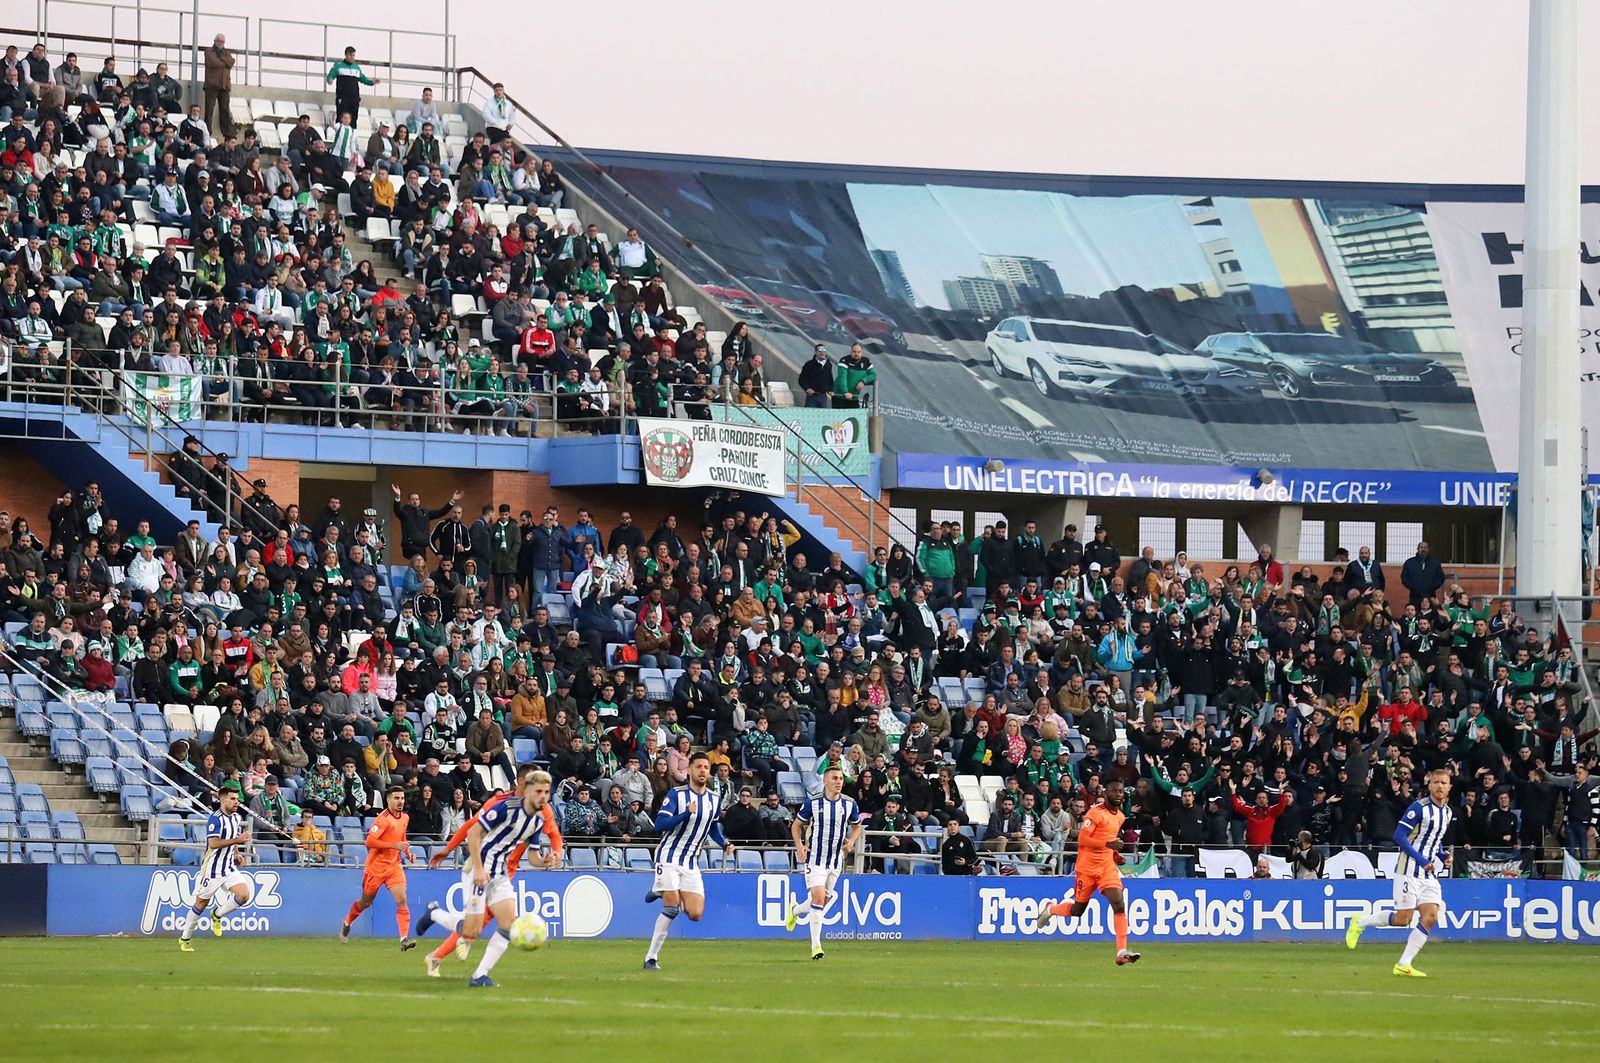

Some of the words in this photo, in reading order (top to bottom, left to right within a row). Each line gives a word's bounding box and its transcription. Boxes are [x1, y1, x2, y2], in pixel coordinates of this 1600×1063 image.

[692, 424, 717, 442] PEÑA
[719, 428, 782, 451] CORDOBESISTA
[709, 466, 738, 483] CRUZ
[944, 465, 1136, 497] UNIELECTRICA
[1179, 479, 1255, 501] energía
[1263, 480, 1295, 502] del
[1402, 882, 1409, 894] 3
[141, 870, 283, 935] MUOZ
[1152, 889, 1245, 936] Palos
[162, 911, 270, 931] deoación
[825, 930, 854, 940] ciudad
